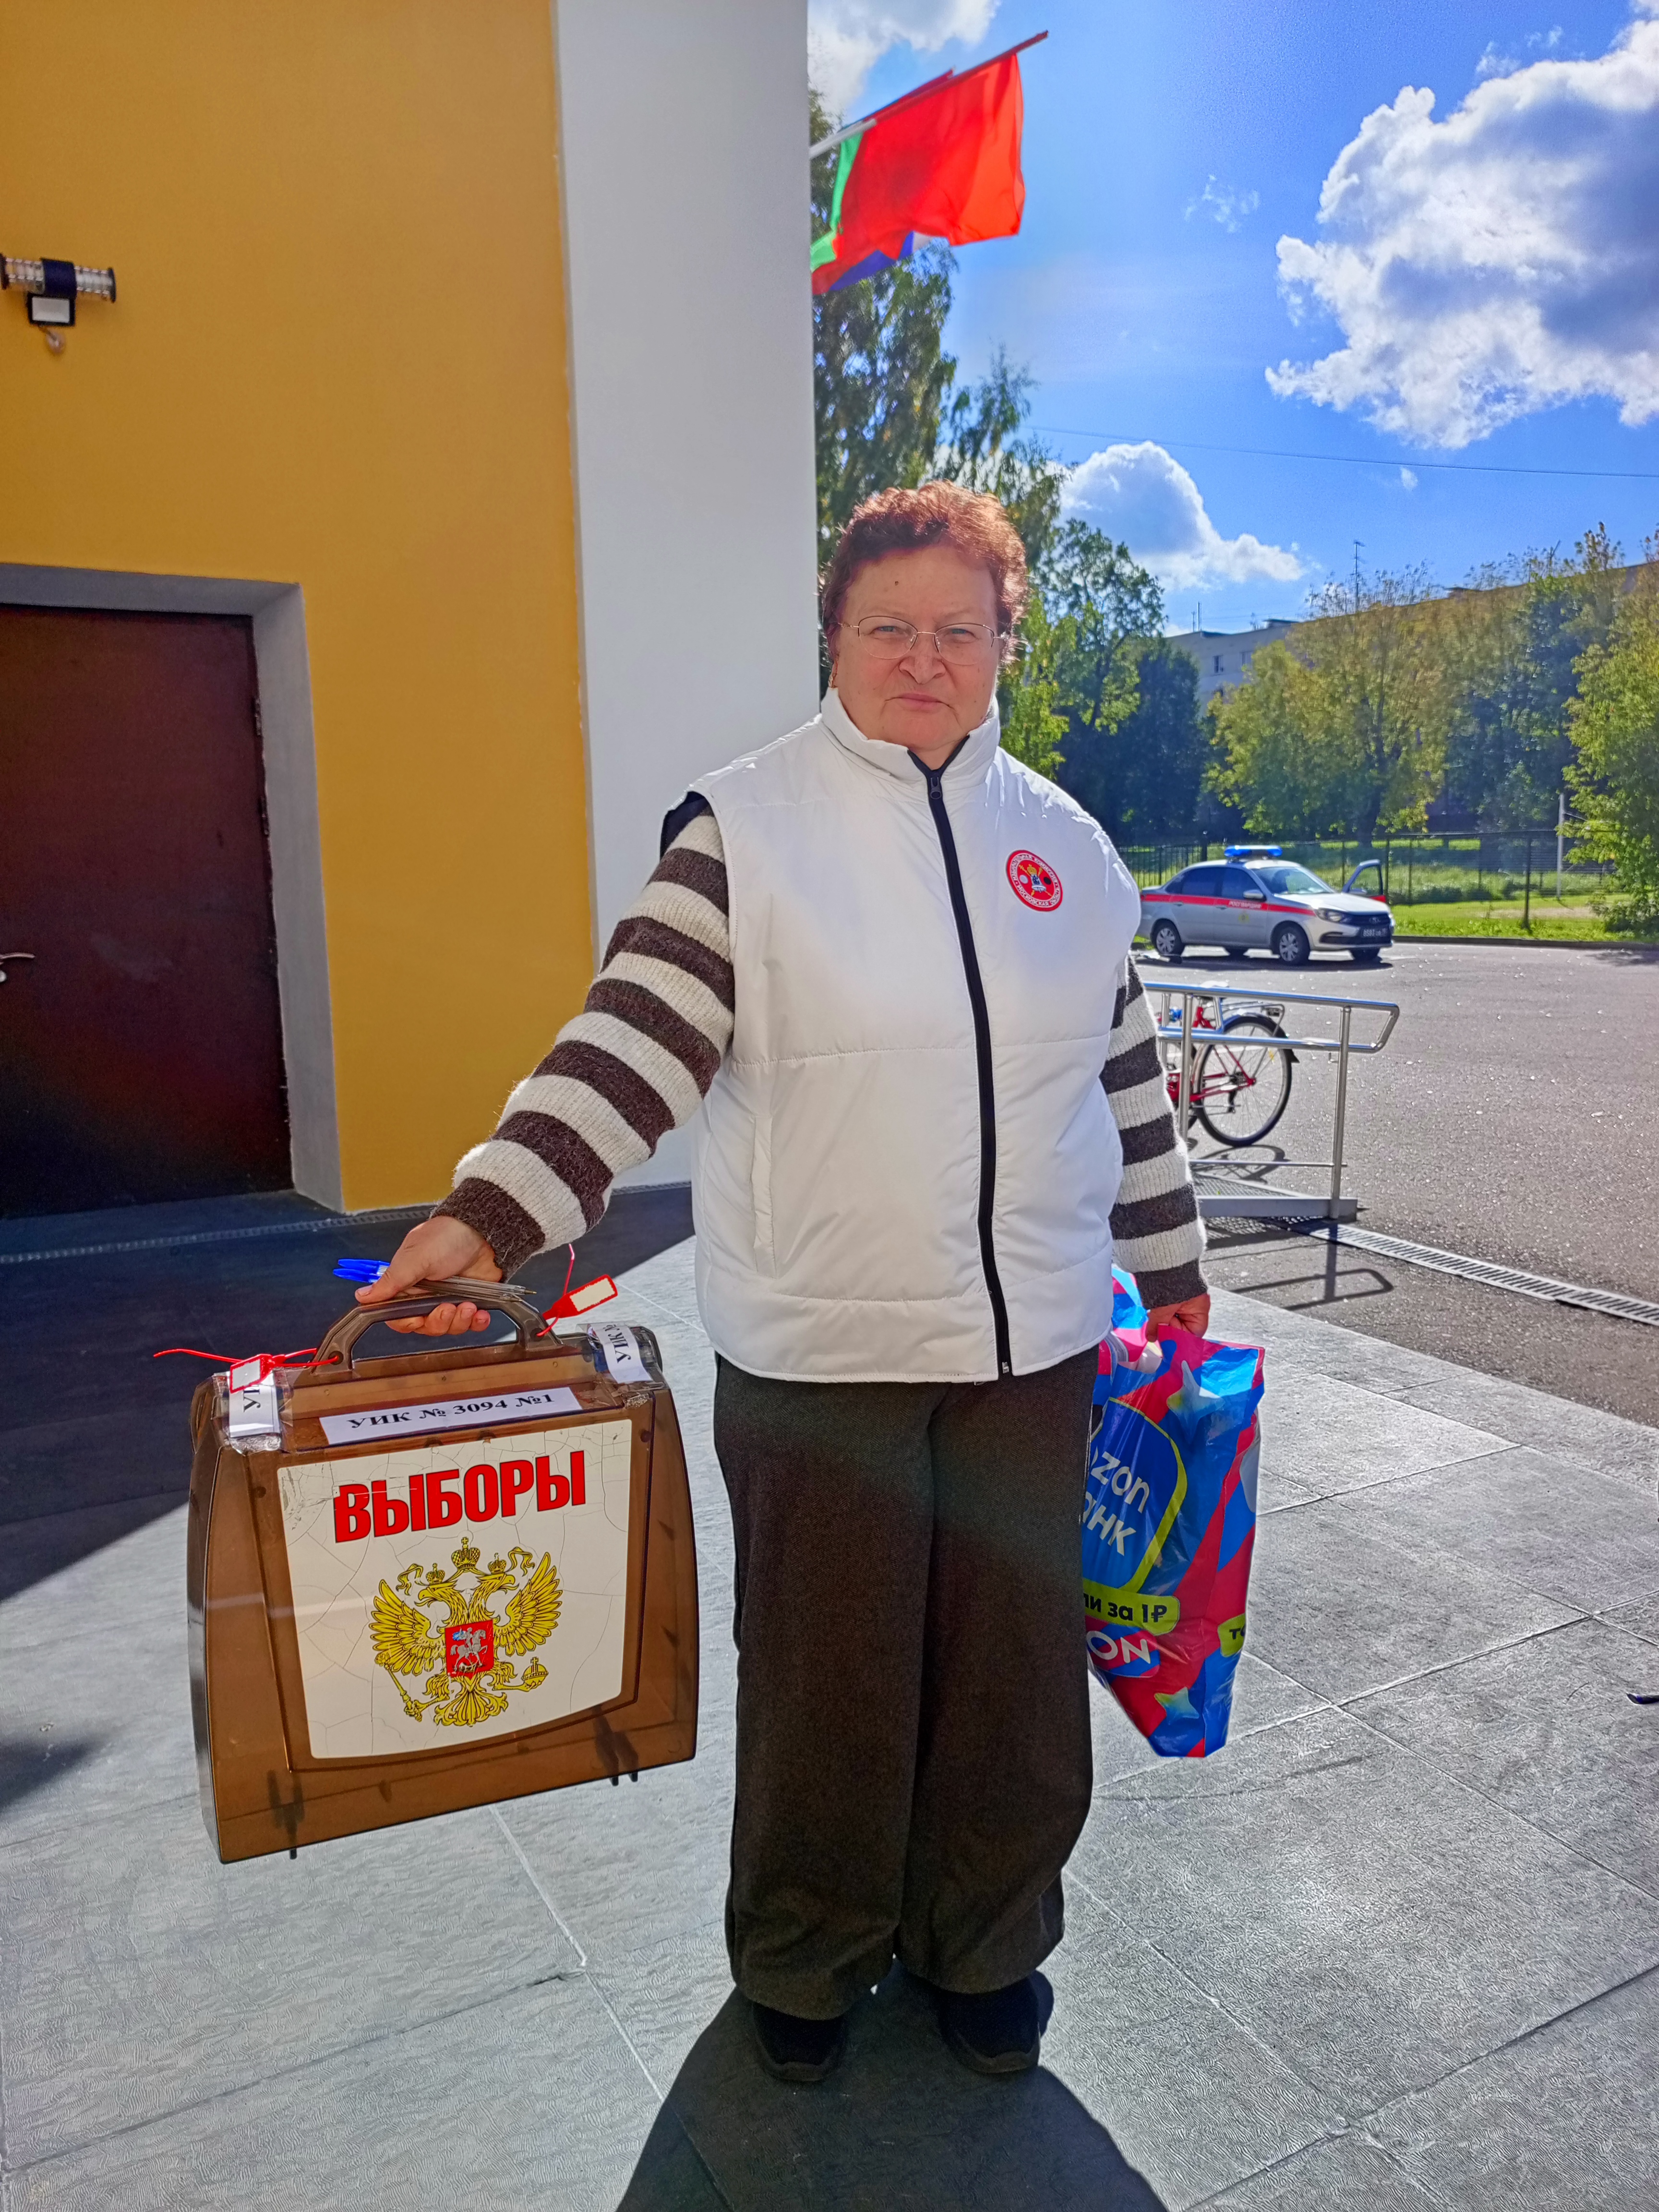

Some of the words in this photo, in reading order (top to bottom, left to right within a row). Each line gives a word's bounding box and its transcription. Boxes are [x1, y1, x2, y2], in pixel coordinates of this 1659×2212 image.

[1017, 884, 1049, 907] МОСКОВСКАЯ
[1229, 901, 1262, 909] РОСГВАРДИЯ
[607, 1333, 631, 1364] УИК
[346, 1411, 412, 1429] УИК
[419, 1407, 447, 1419] №
[453, 1399, 508, 1415] 3094
[515, 1394, 555, 1408] №1
[1091, 1445, 1150, 1514] zon
[333, 1450, 586, 1544] ВЫБОРЫ
[1107, 1601, 1133, 1621] за
[1086, 1630, 1151, 1664] ON
